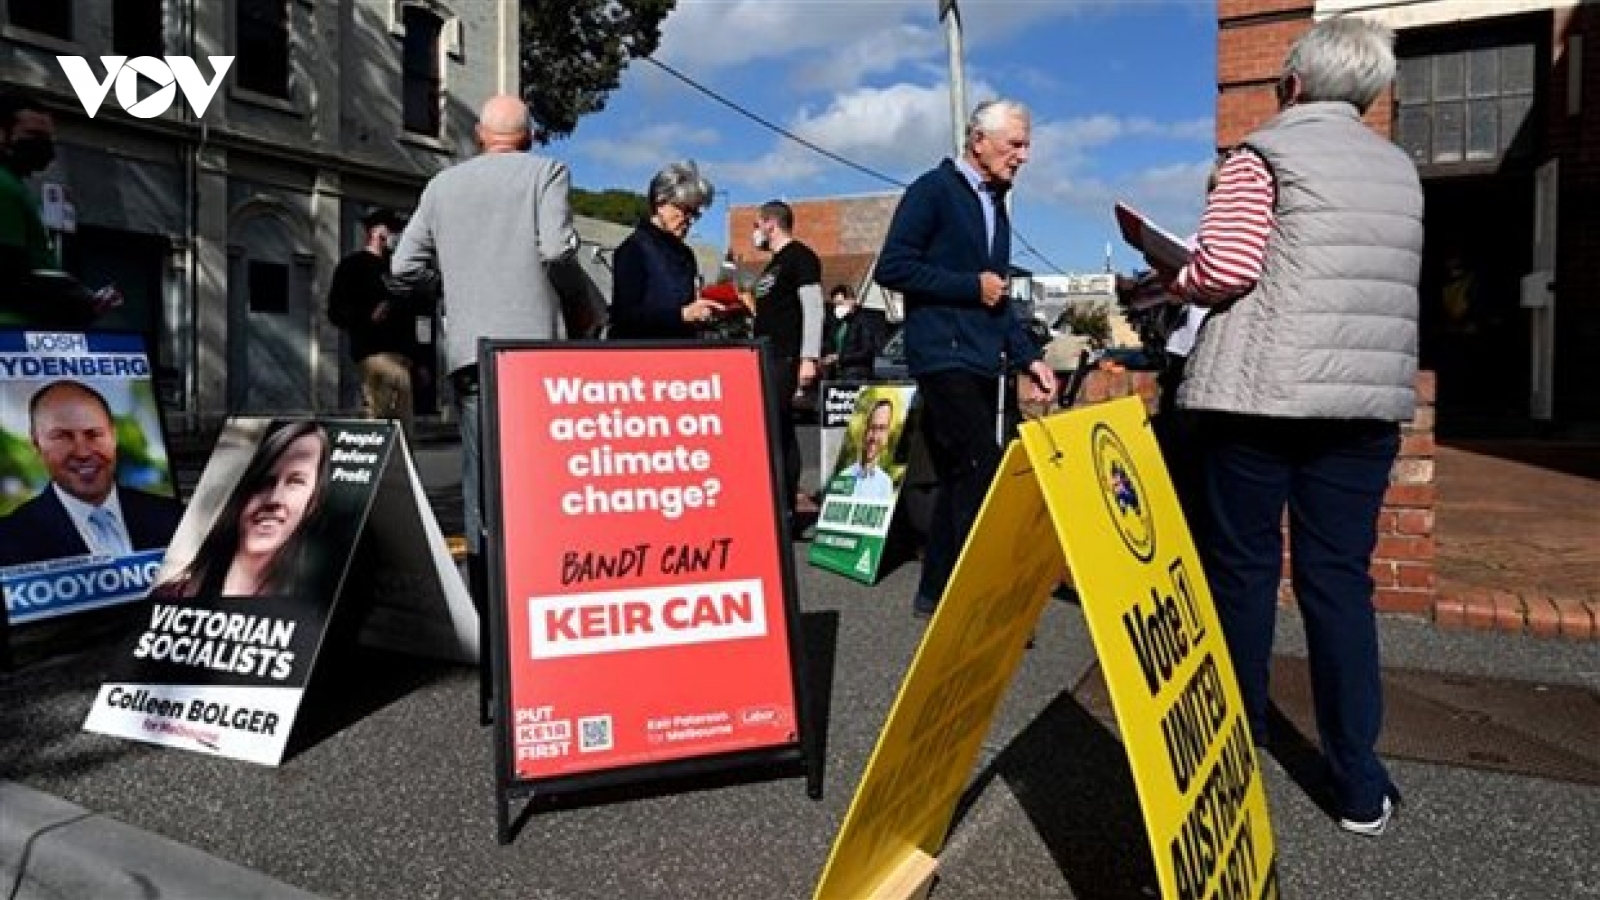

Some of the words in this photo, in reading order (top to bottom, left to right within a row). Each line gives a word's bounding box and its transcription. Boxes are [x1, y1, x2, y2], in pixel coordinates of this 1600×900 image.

[31, 334, 83, 353] JOSH
[544, 375, 645, 404] Want
[652, 373, 722, 401] real
[336, 430, 385, 447] People
[549, 409, 671, 441] action
[677, 413, 723, 436] on
[331, 448, 378, 463] Before
[567, 445, 711, 477] climate
[332, 467, 372, 484] Profit
[561, 478, 721, 519] change?
[561, 543, 651, 584] BANDT
[660, 537, 733, 576] CAN'T
[151, 604, 296, 649] VICTORIAN
[545, 602, 655, 642] KEIR
[662, 592, 753, 630] CAN
[133, 630, 295, 680] SOCIALISTS
[1122, 587, 1188, 698] Vote
[106, 687, 184, 719] Colleen
[186, 699, 279, 736] BOLGER
[516, 706, 554, 722] PUT
[743, 710, 775, 725] Labor
[1160, 652, 1227, 794] UNITED
[518, 742, 570, 760] FIRST
[1170, 713, 1254, 900] AUSTRALIA
